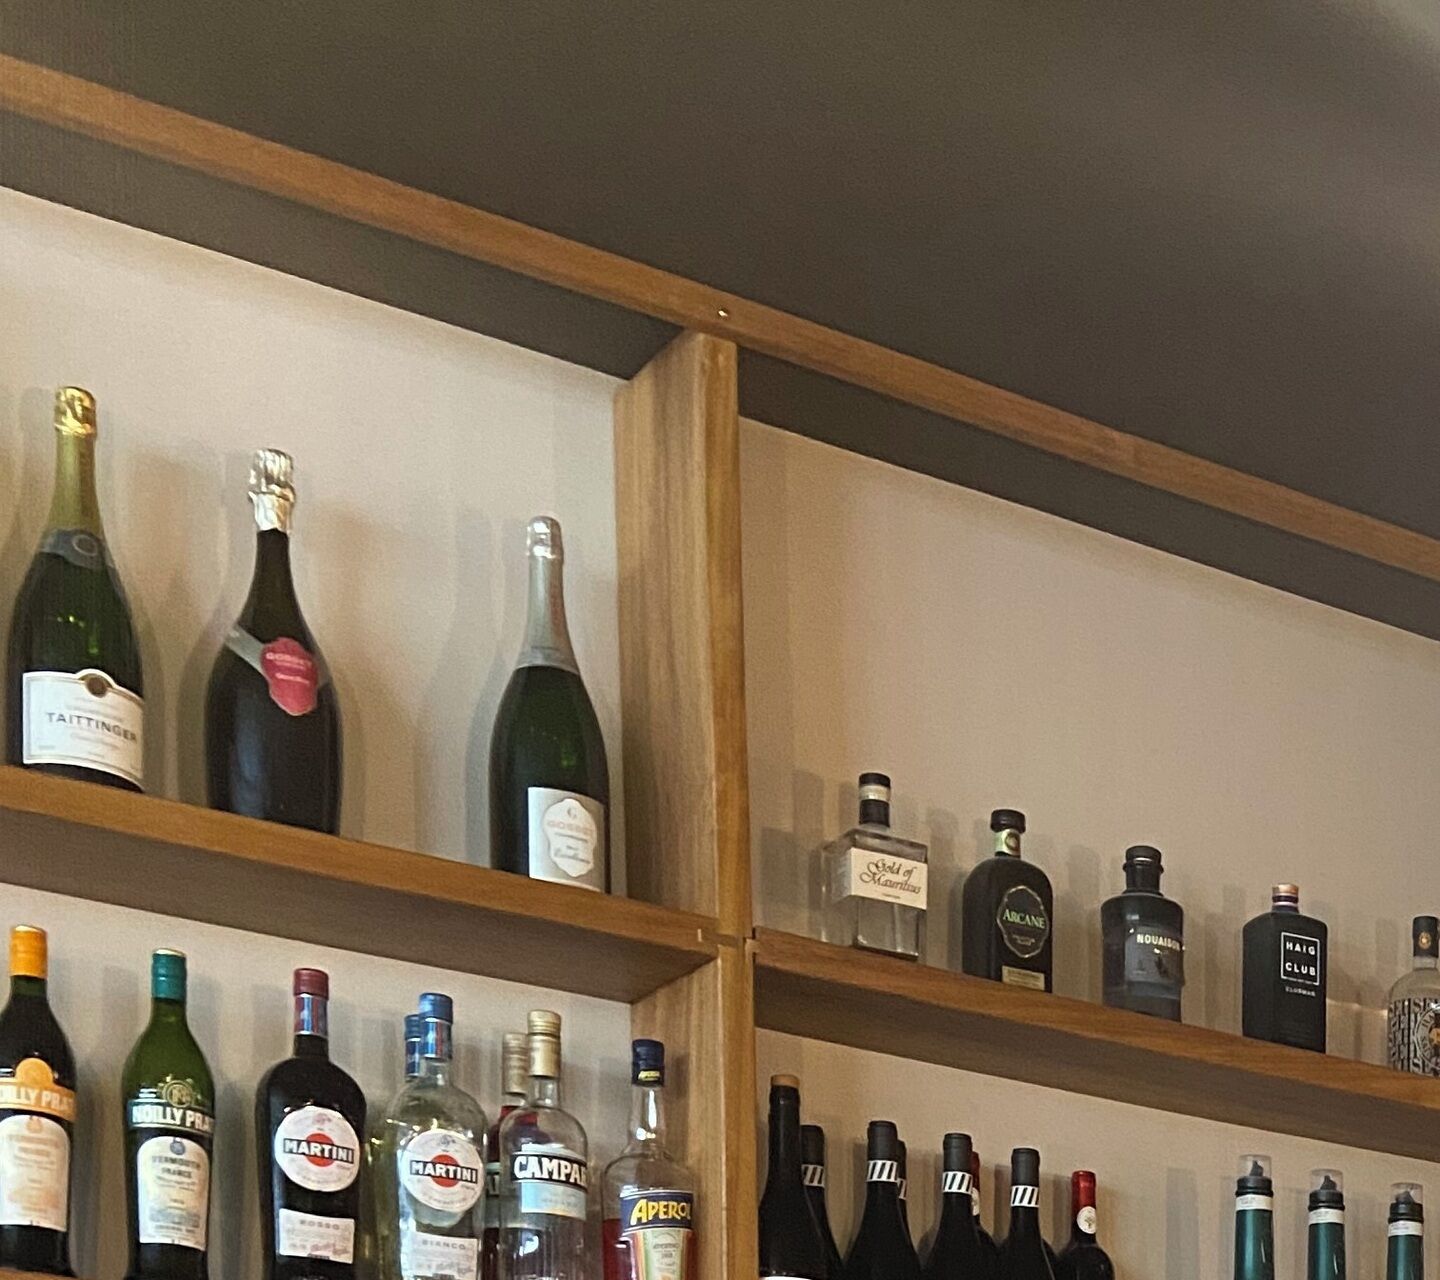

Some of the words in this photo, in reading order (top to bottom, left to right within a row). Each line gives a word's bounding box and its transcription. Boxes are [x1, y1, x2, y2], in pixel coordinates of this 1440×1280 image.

[47, 712, 137, 741] TAITTINGER
[867, 858, 902, 875] Gold
[903, 866, 918, 883] of
[1003, 908, 1046, 929] ARCANE
[1286, 941, 1316, 955] HAIG
[1285, 962, 1316, 976] CLUB
[131, 1103, 183, 1126] NOILLY
[185, 1108, 214, 1132] PRA
[285, 1139, 353, 1163] MARTINI
[411, 1160, 477, 1184] MARTINI
